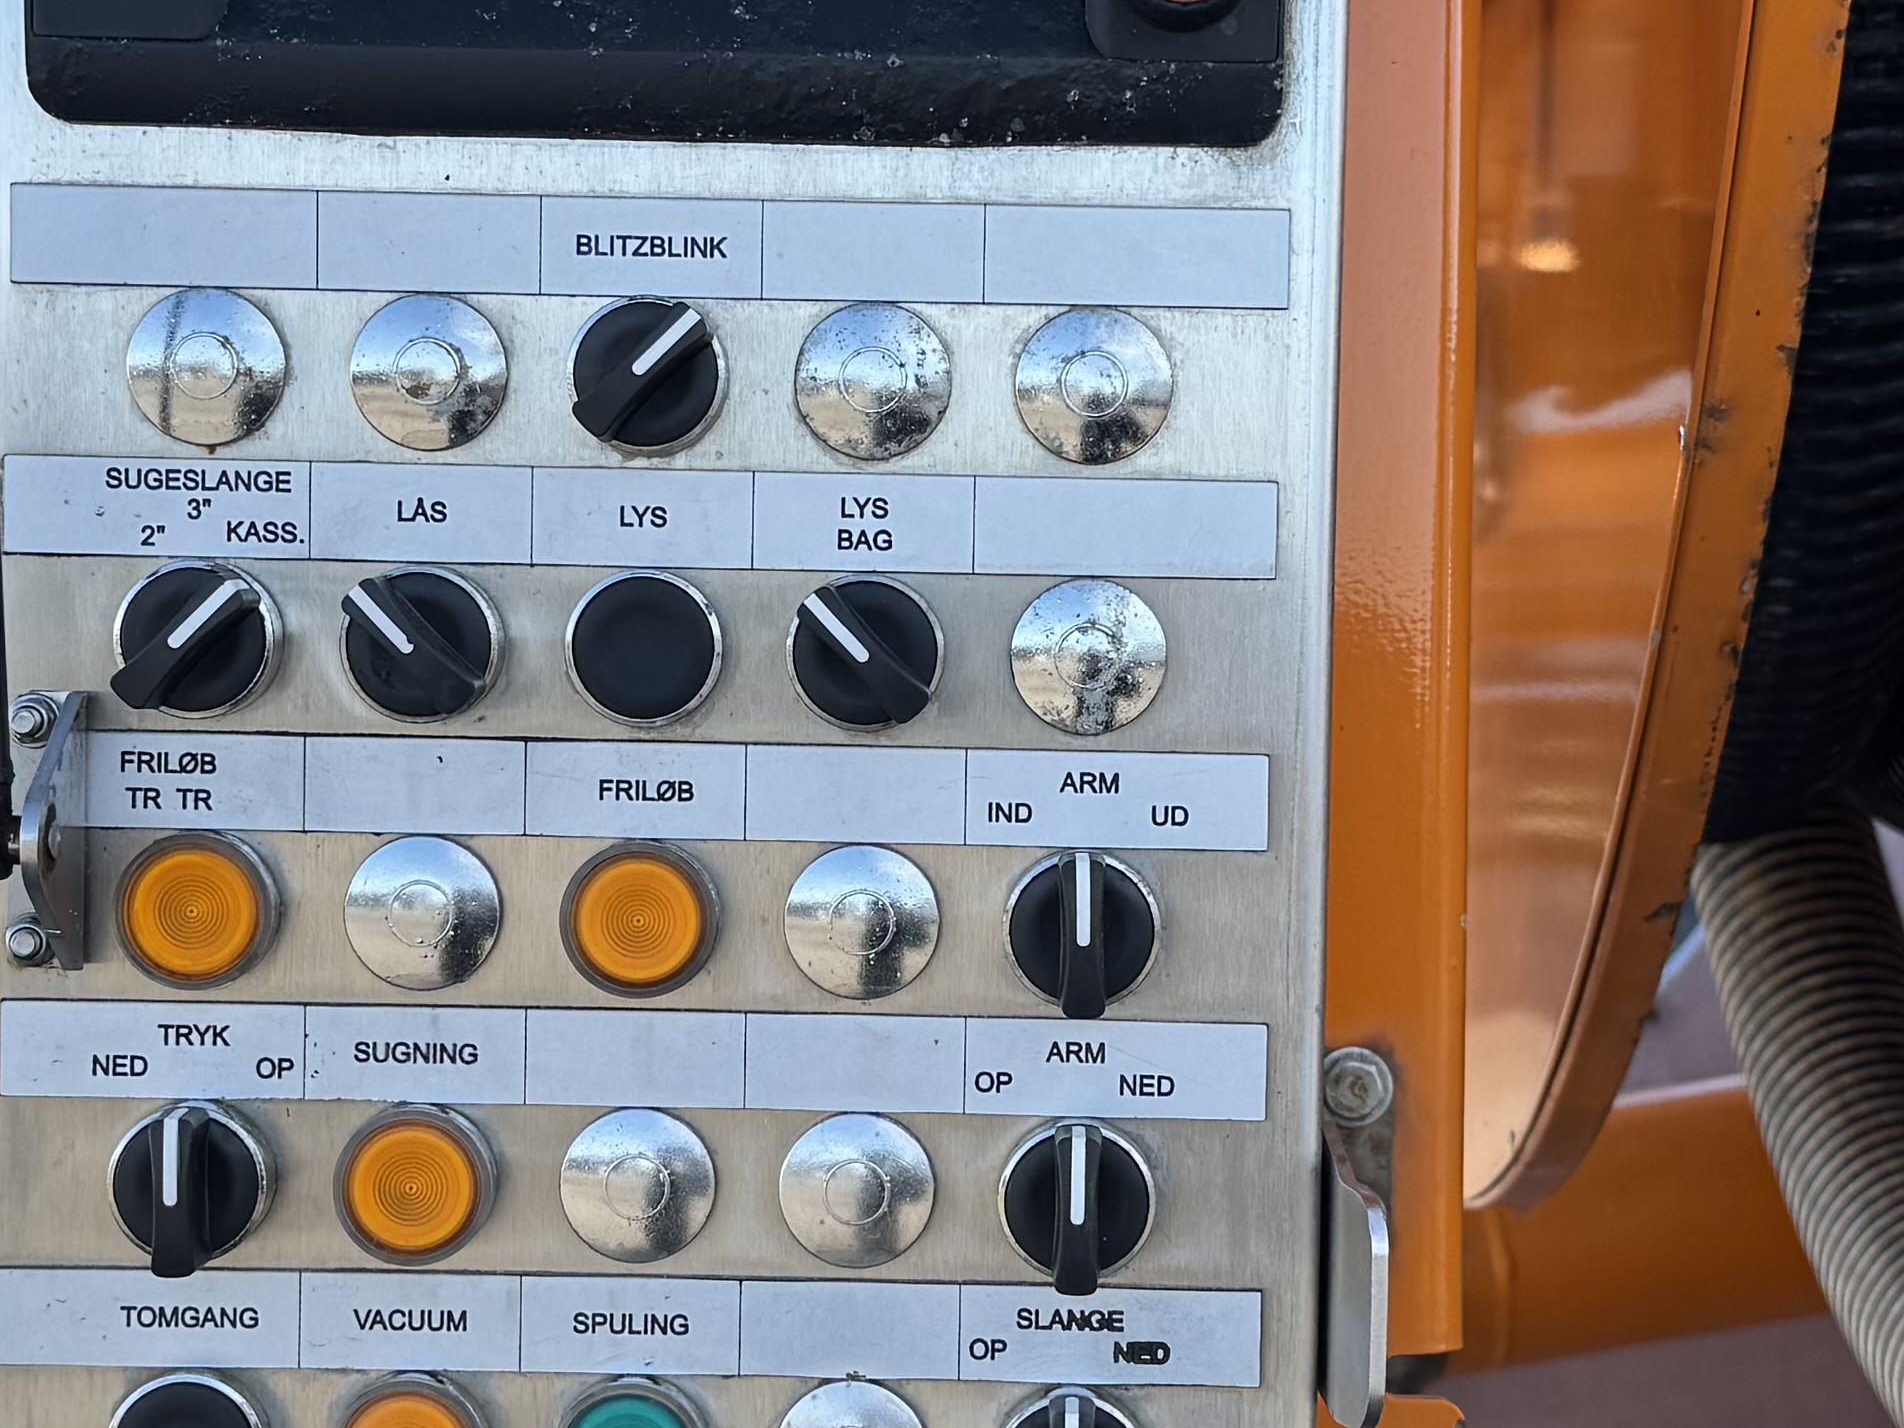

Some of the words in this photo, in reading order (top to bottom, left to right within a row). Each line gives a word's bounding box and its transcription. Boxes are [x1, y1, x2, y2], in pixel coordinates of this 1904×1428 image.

[575, 233, 728, 259] BLITZBLINK
[105, 466, 293, 494] SUGESLANGE
[186, 497, 212, 521] 3"
[397, 496, 448, 524] LÅS
[619, 504, 668, 530] LYS
[840, 496, 889, 521] LYS
[140, 524, 166, 548] 2"
[226, 519, 305, 545] KASS.
[837, 528, 893, 553] BAG
[120, 750, 217, 776] FRILØB
[598, 778, 695, 804] FRILØB
[1059, 771, 1121, 796] ARM
[124, 786, 162, 811] TR
[175, 787, 213, 812] TR
[987, 801, 1034, 825] IND
[1151, 804, 1191, 828] UD
[157, 1023, 232, 1048] TRYK
[353, 1041, 479, 1067] SUGNING
[1045, 1040, 1107, 1065] ARM
[91, 1053, 149, 1078] NED
[255, 1056, 296, 1081] OP
[974, 1071, 1013, 1095] OP
[1119, 1073, 1176, 1098] NED
[119, 1305, 260, 1330] TOMGANG
[352, 1308, 469, 1333] VACUUM
[572, 1311, 690, 1337] SPULING
[1015, 1307, 1126, 1333] SLANGE
[968, 1337, 1008, 1362] OP
